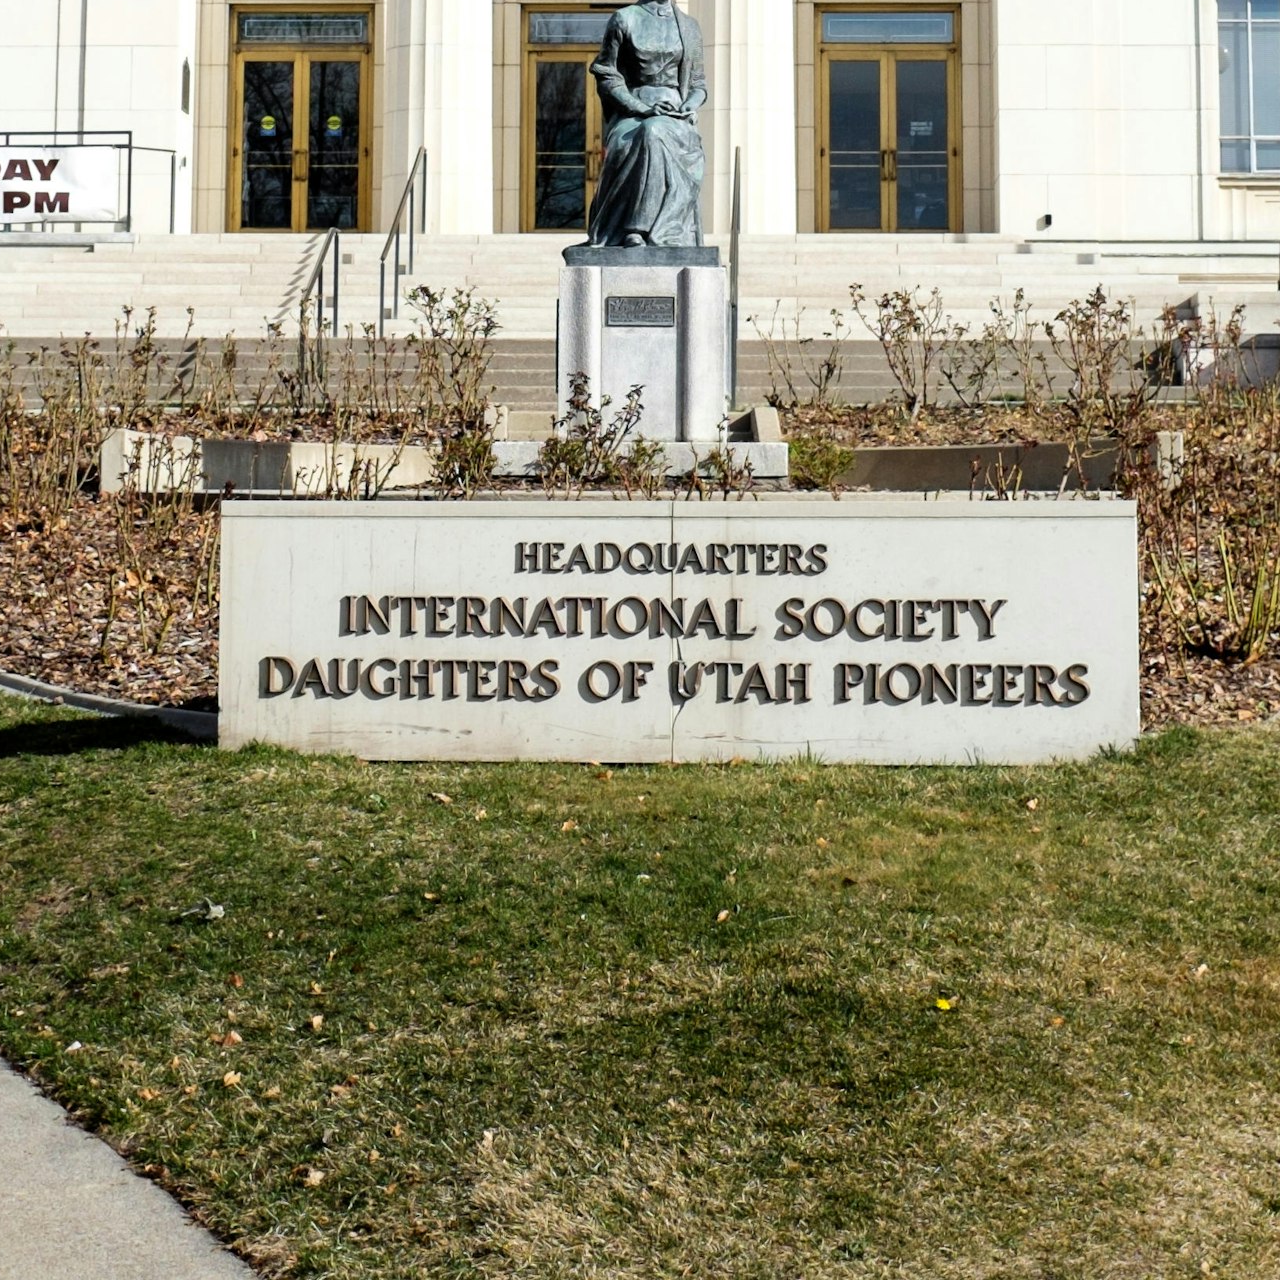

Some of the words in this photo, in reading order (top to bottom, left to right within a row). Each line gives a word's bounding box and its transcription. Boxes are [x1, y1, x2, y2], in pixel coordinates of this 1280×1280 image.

[3, 191, 70, 214] PM
[514, 541, 829, 576] HEADQUARTERS
[338, 594, 758, 640] INTERNATIONAL
[774, 596, 1009, 642] SOCIETY
[258, 655, 562, 703] DAUGHTERS
[578, 659, 656, 704] OF
[668, 661, 813, 705] UTAH
[833, 662, 1092, 707] PIONEERS
